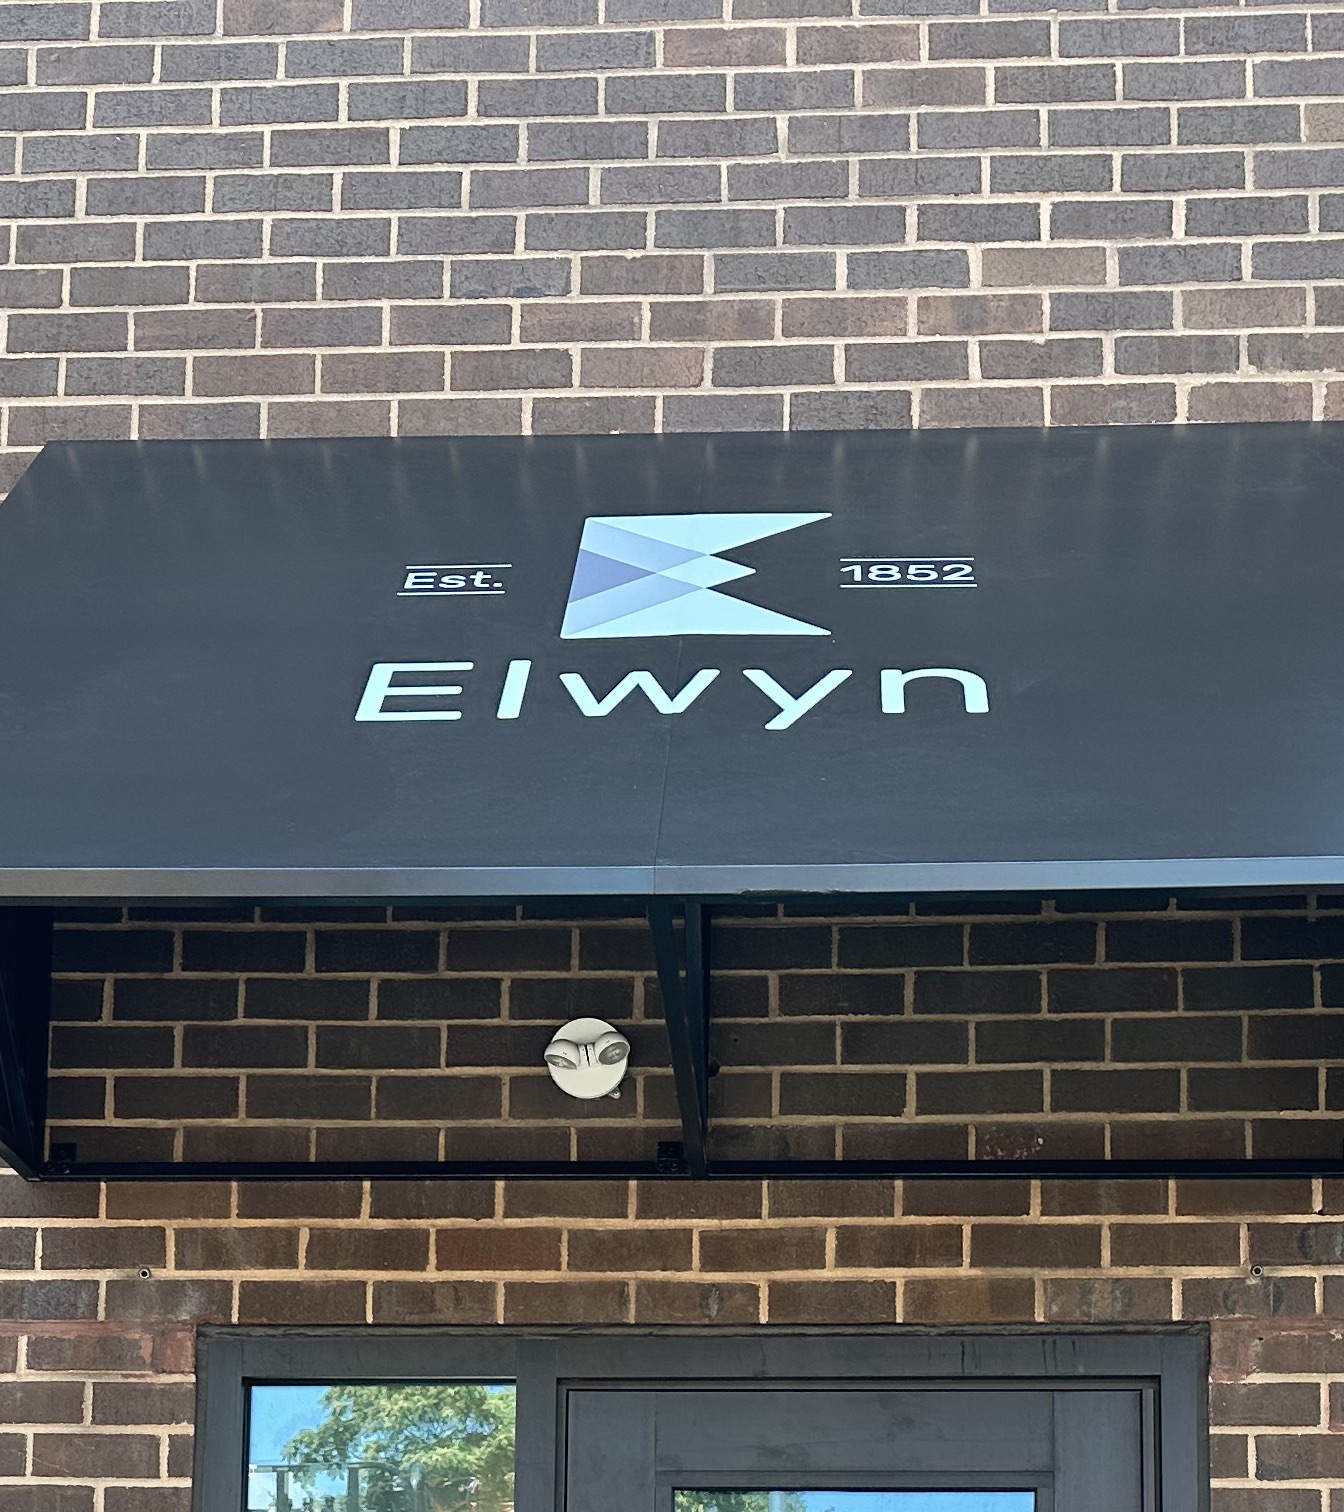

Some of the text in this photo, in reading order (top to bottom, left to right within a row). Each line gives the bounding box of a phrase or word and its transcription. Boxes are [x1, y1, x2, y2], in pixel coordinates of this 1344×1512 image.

[402, 569, 505, 591] Est.
[840, 561, 976, 583] 1852
[354, 658, 991, 731] Elwyn
